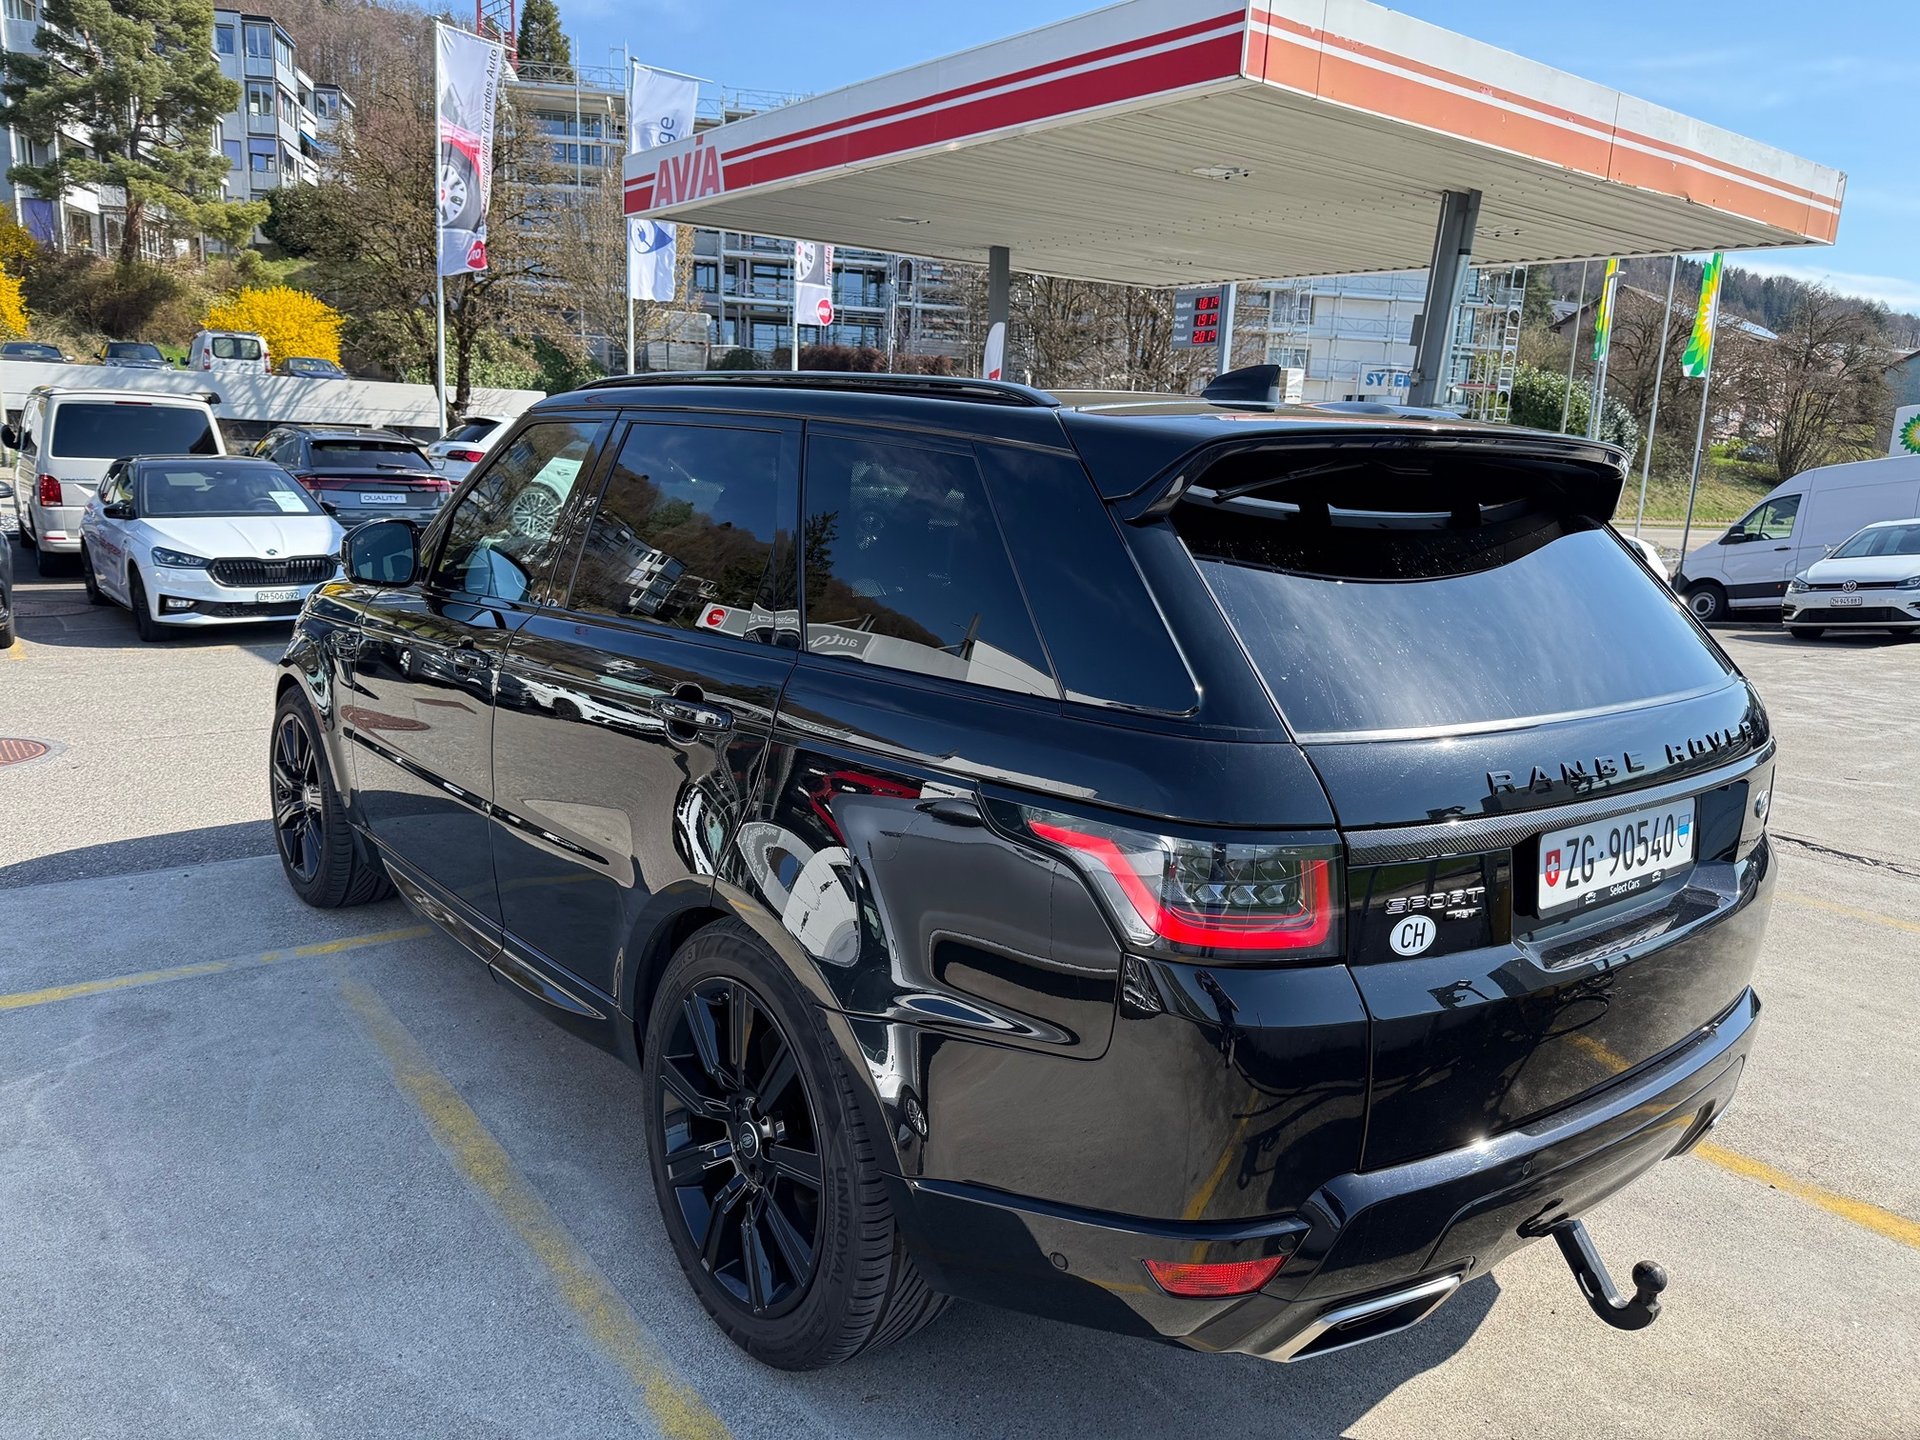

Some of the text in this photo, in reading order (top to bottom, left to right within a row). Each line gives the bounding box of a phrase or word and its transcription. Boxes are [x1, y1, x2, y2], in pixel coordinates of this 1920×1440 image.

[486, 49, 498, 79] Auto
[482, 81, 494, 116] jedes
[1486, 721, 1754, 798] RANGE ROVER
[1385, 886, 1485, 915] SPORT
[1609, 881, 1628, 896] Select
[1627, 879, 1640, 890] Cars
[1400, 922, 1427, 949] CH
[830, 1166, 851, 1285] UNIROYAL
